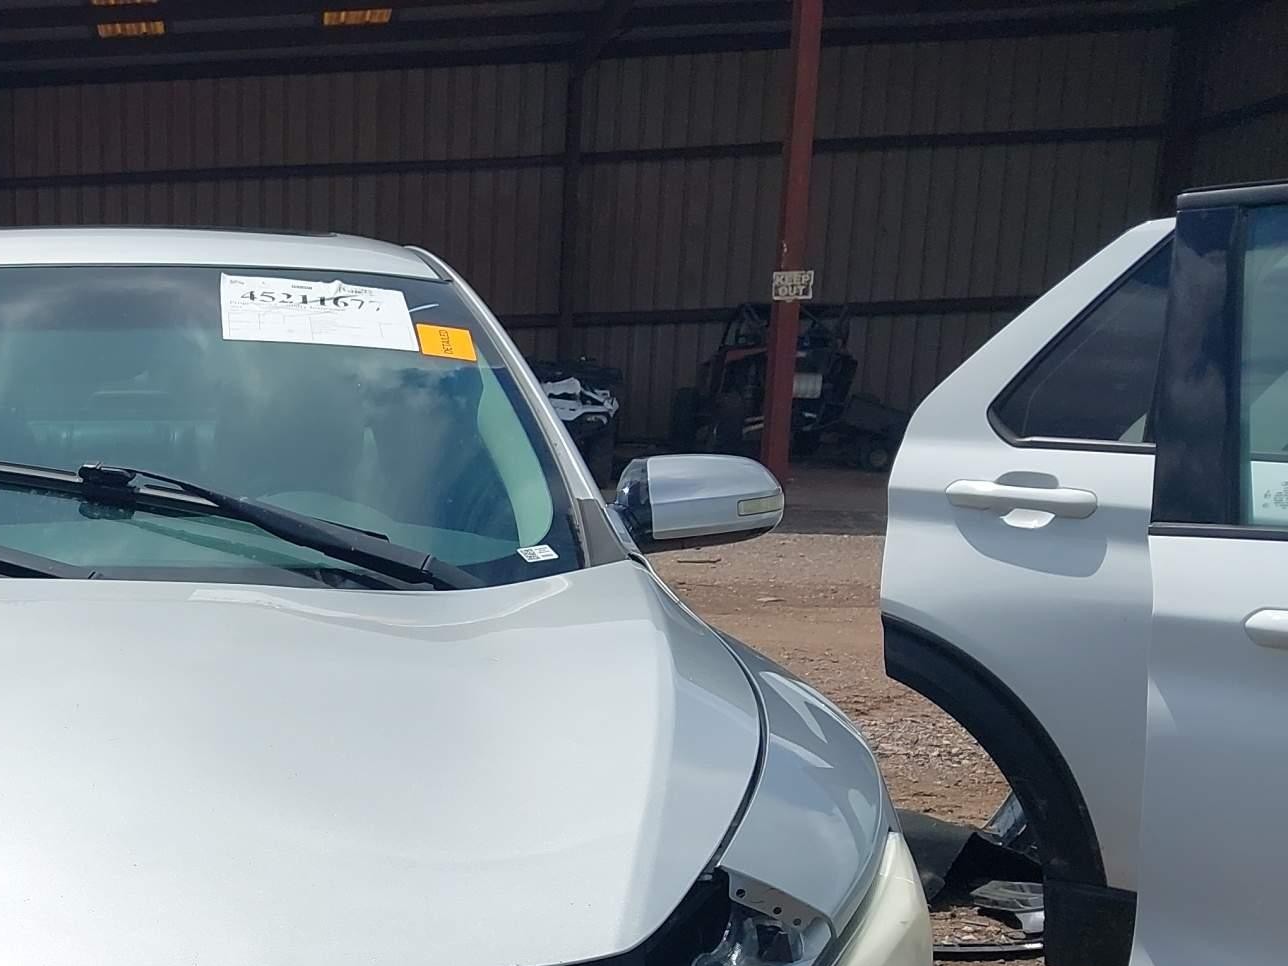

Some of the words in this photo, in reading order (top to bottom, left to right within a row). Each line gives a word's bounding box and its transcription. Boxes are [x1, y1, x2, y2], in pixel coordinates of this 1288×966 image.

[775, 274, 810, 285] KEEP
[777, 285, 806, 297] OUT
[438, 328, 454, 355] DETAILED
